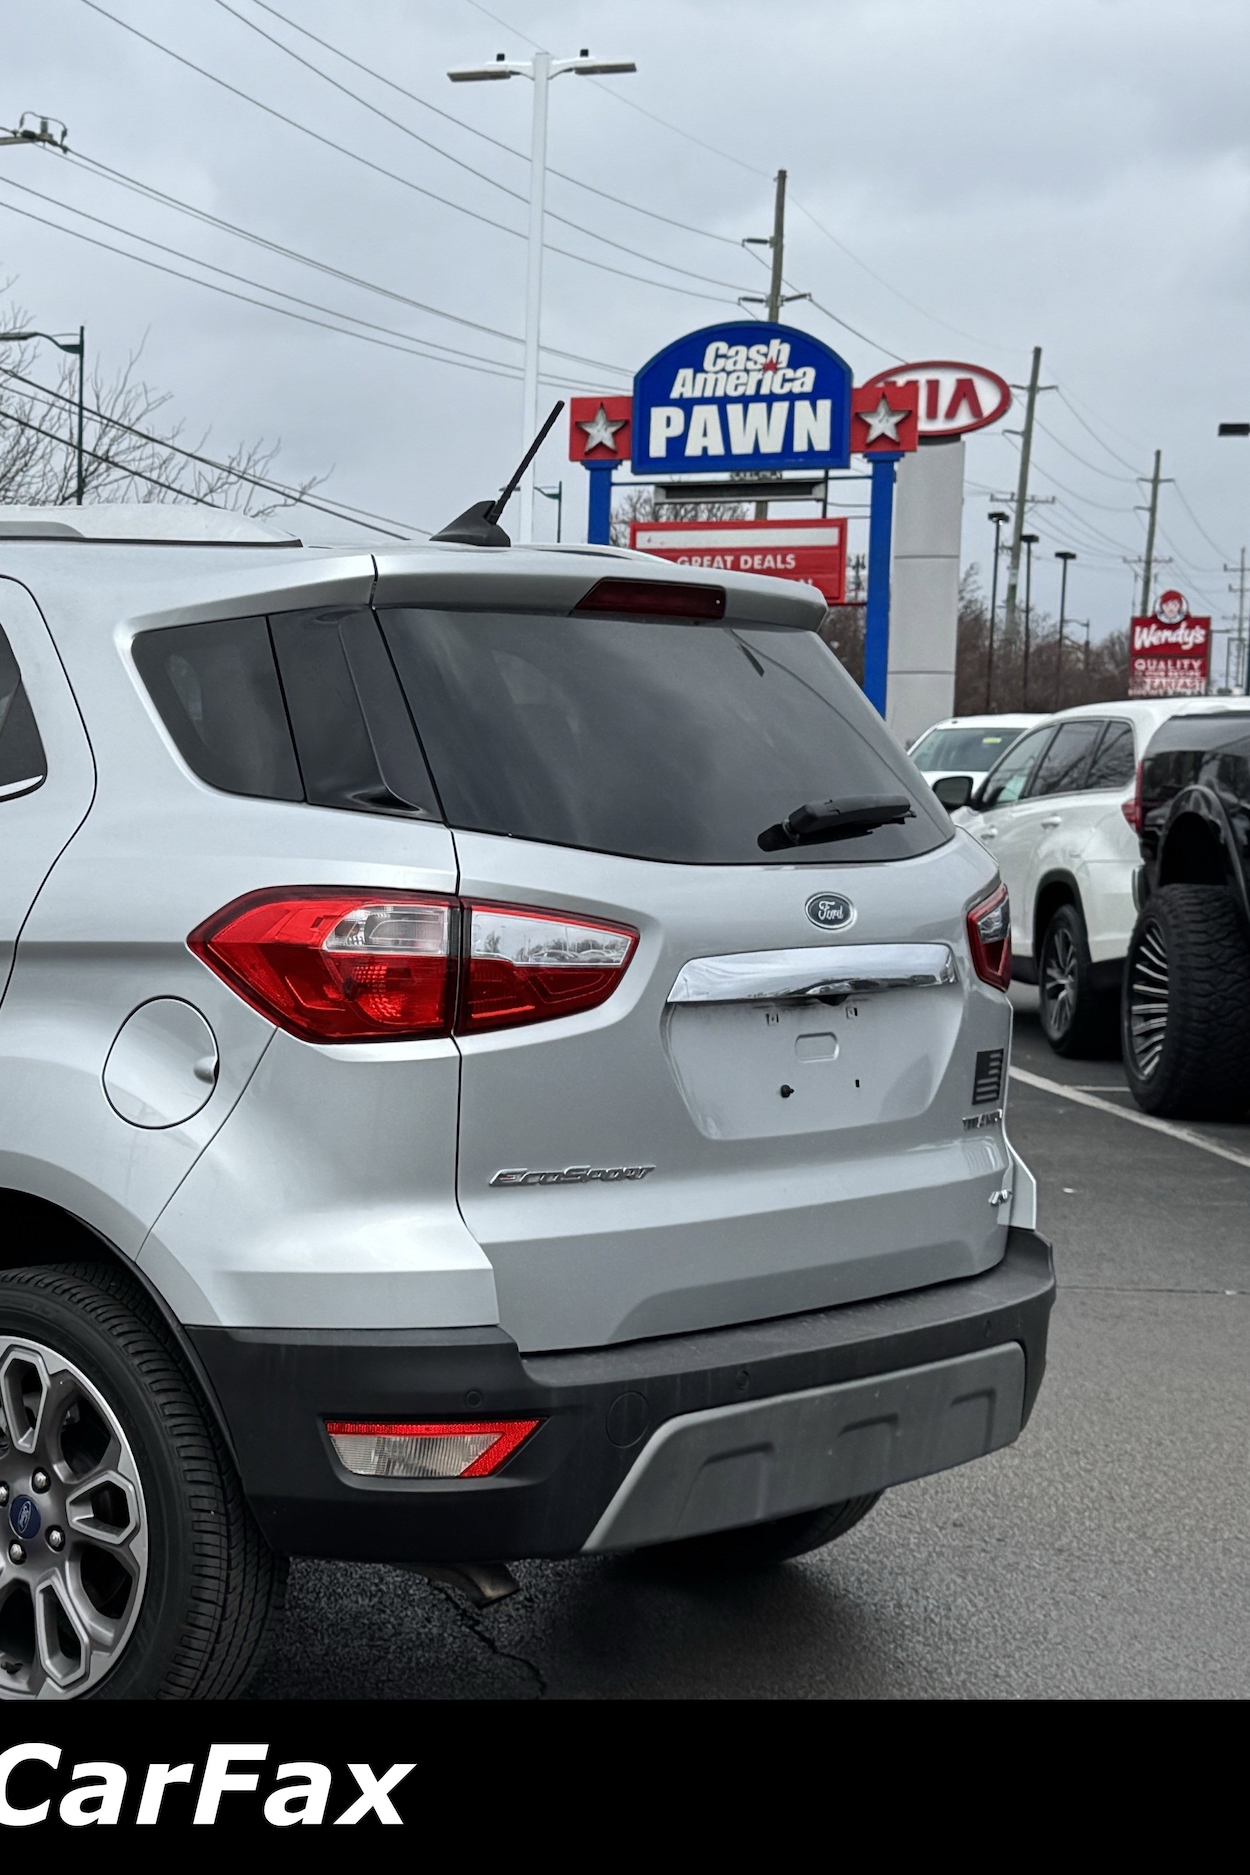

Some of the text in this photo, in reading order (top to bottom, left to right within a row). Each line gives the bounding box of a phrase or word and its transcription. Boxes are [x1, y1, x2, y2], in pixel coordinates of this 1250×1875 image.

[703, 338, 791, 373] Cash
[669, 366, 816, 399] America
[884, 377, 983, 420] IA
[649, 399, 832, 458] PAWN
[739, 553, 796, 570] DEALS
[1134, 621, 1206, 651] Wendy's
[1134, 658, 1203, 671] QUALITY
[817, 900, 845, 921] Ford
